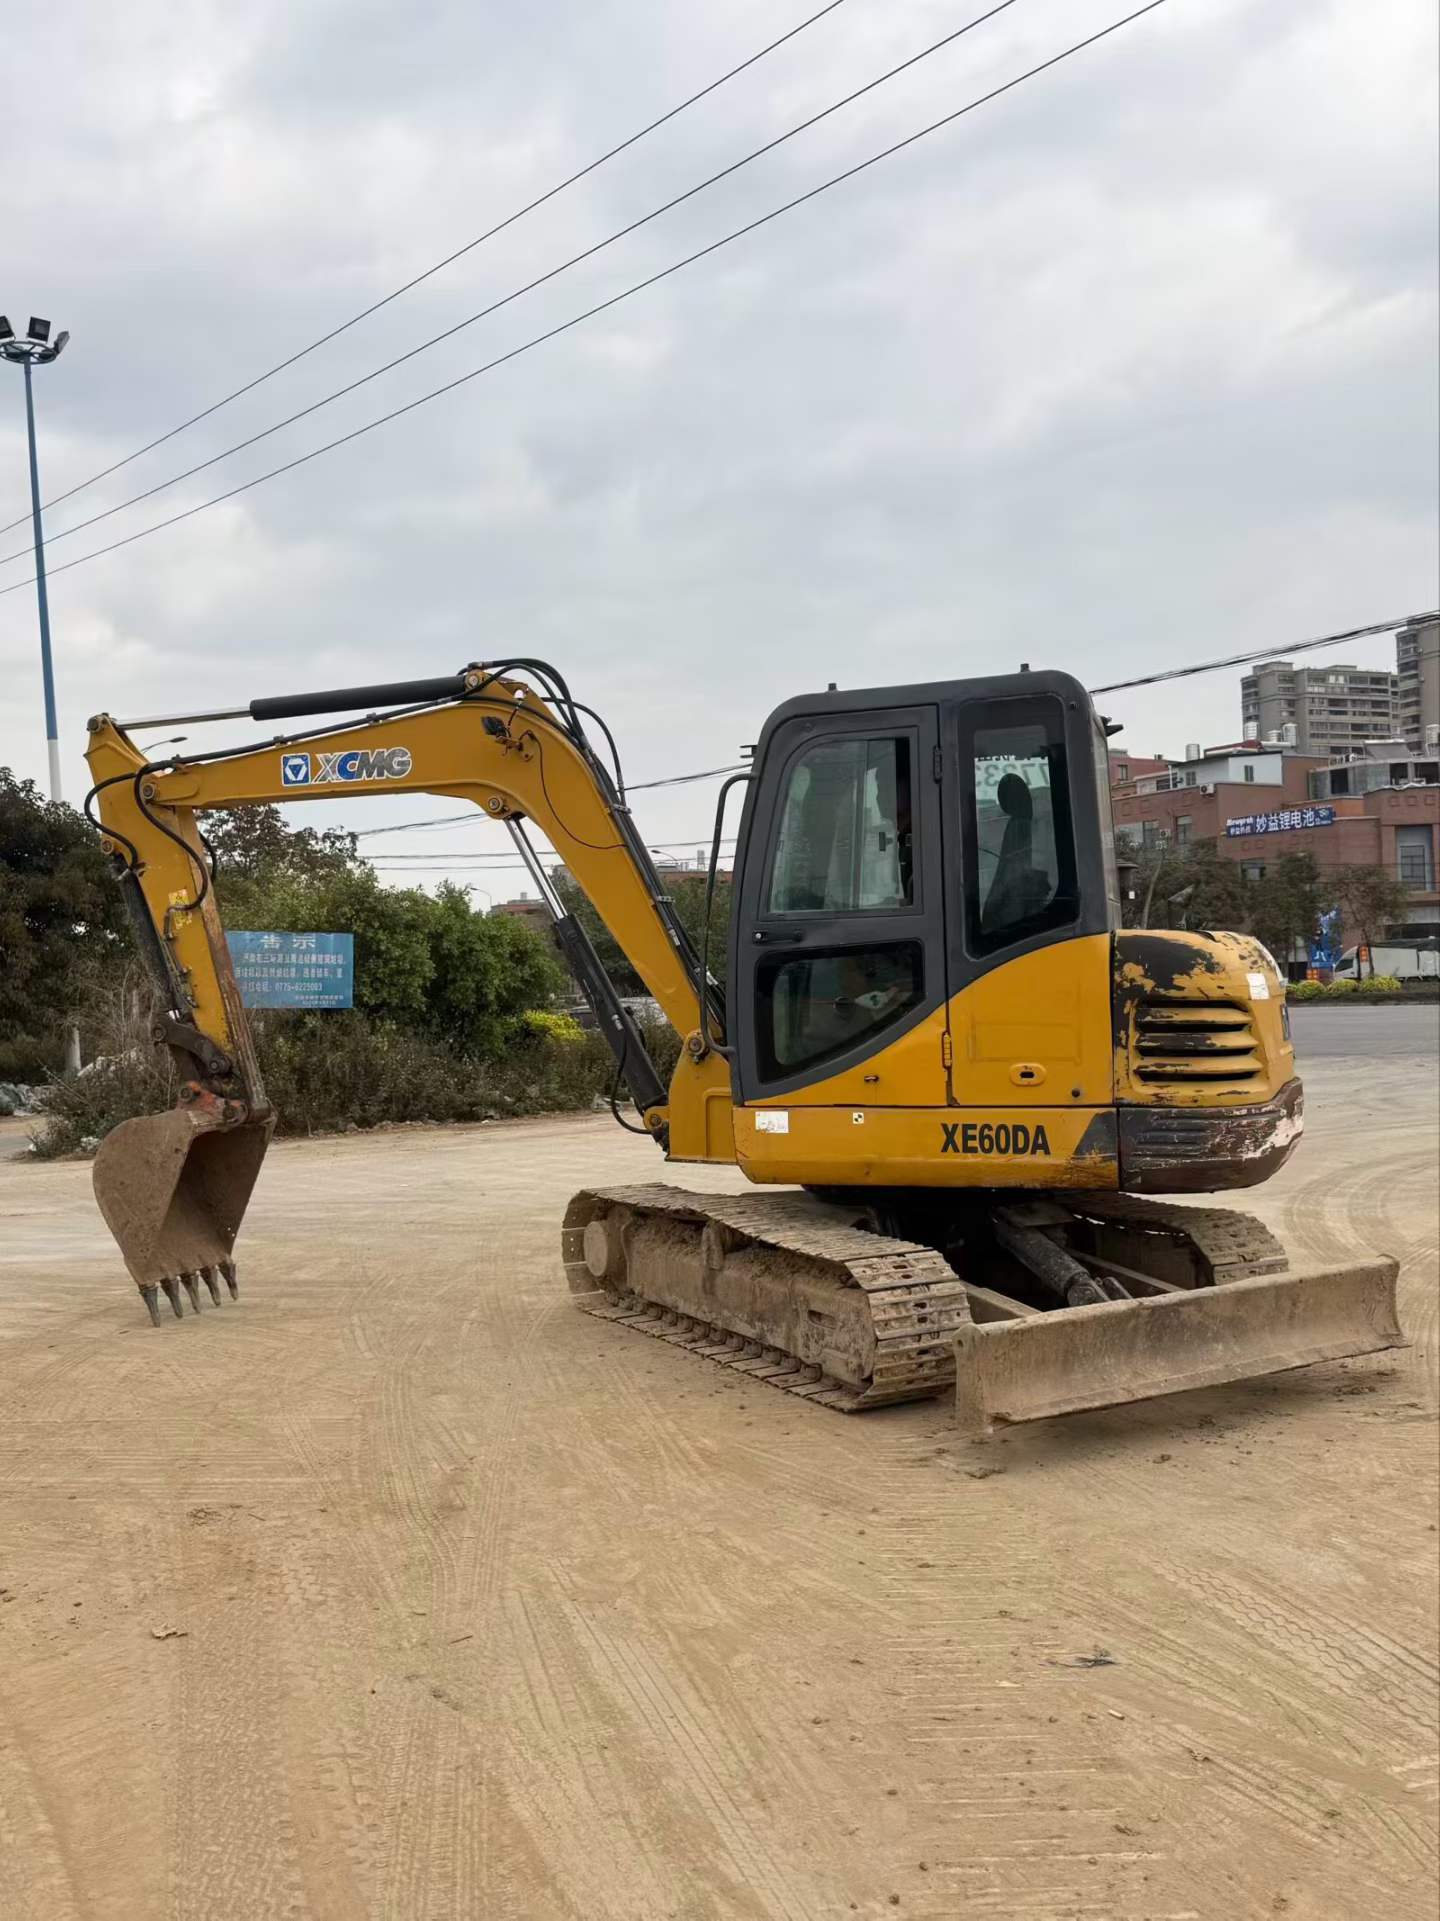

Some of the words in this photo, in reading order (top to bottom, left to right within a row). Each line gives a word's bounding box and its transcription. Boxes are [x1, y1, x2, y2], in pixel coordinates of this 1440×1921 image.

[312, 747, 412, 784] XCMG
[1255, 808, 1315, 833] 妙益锂电池
[941, 1123, 1050, 1155] XE60DA
